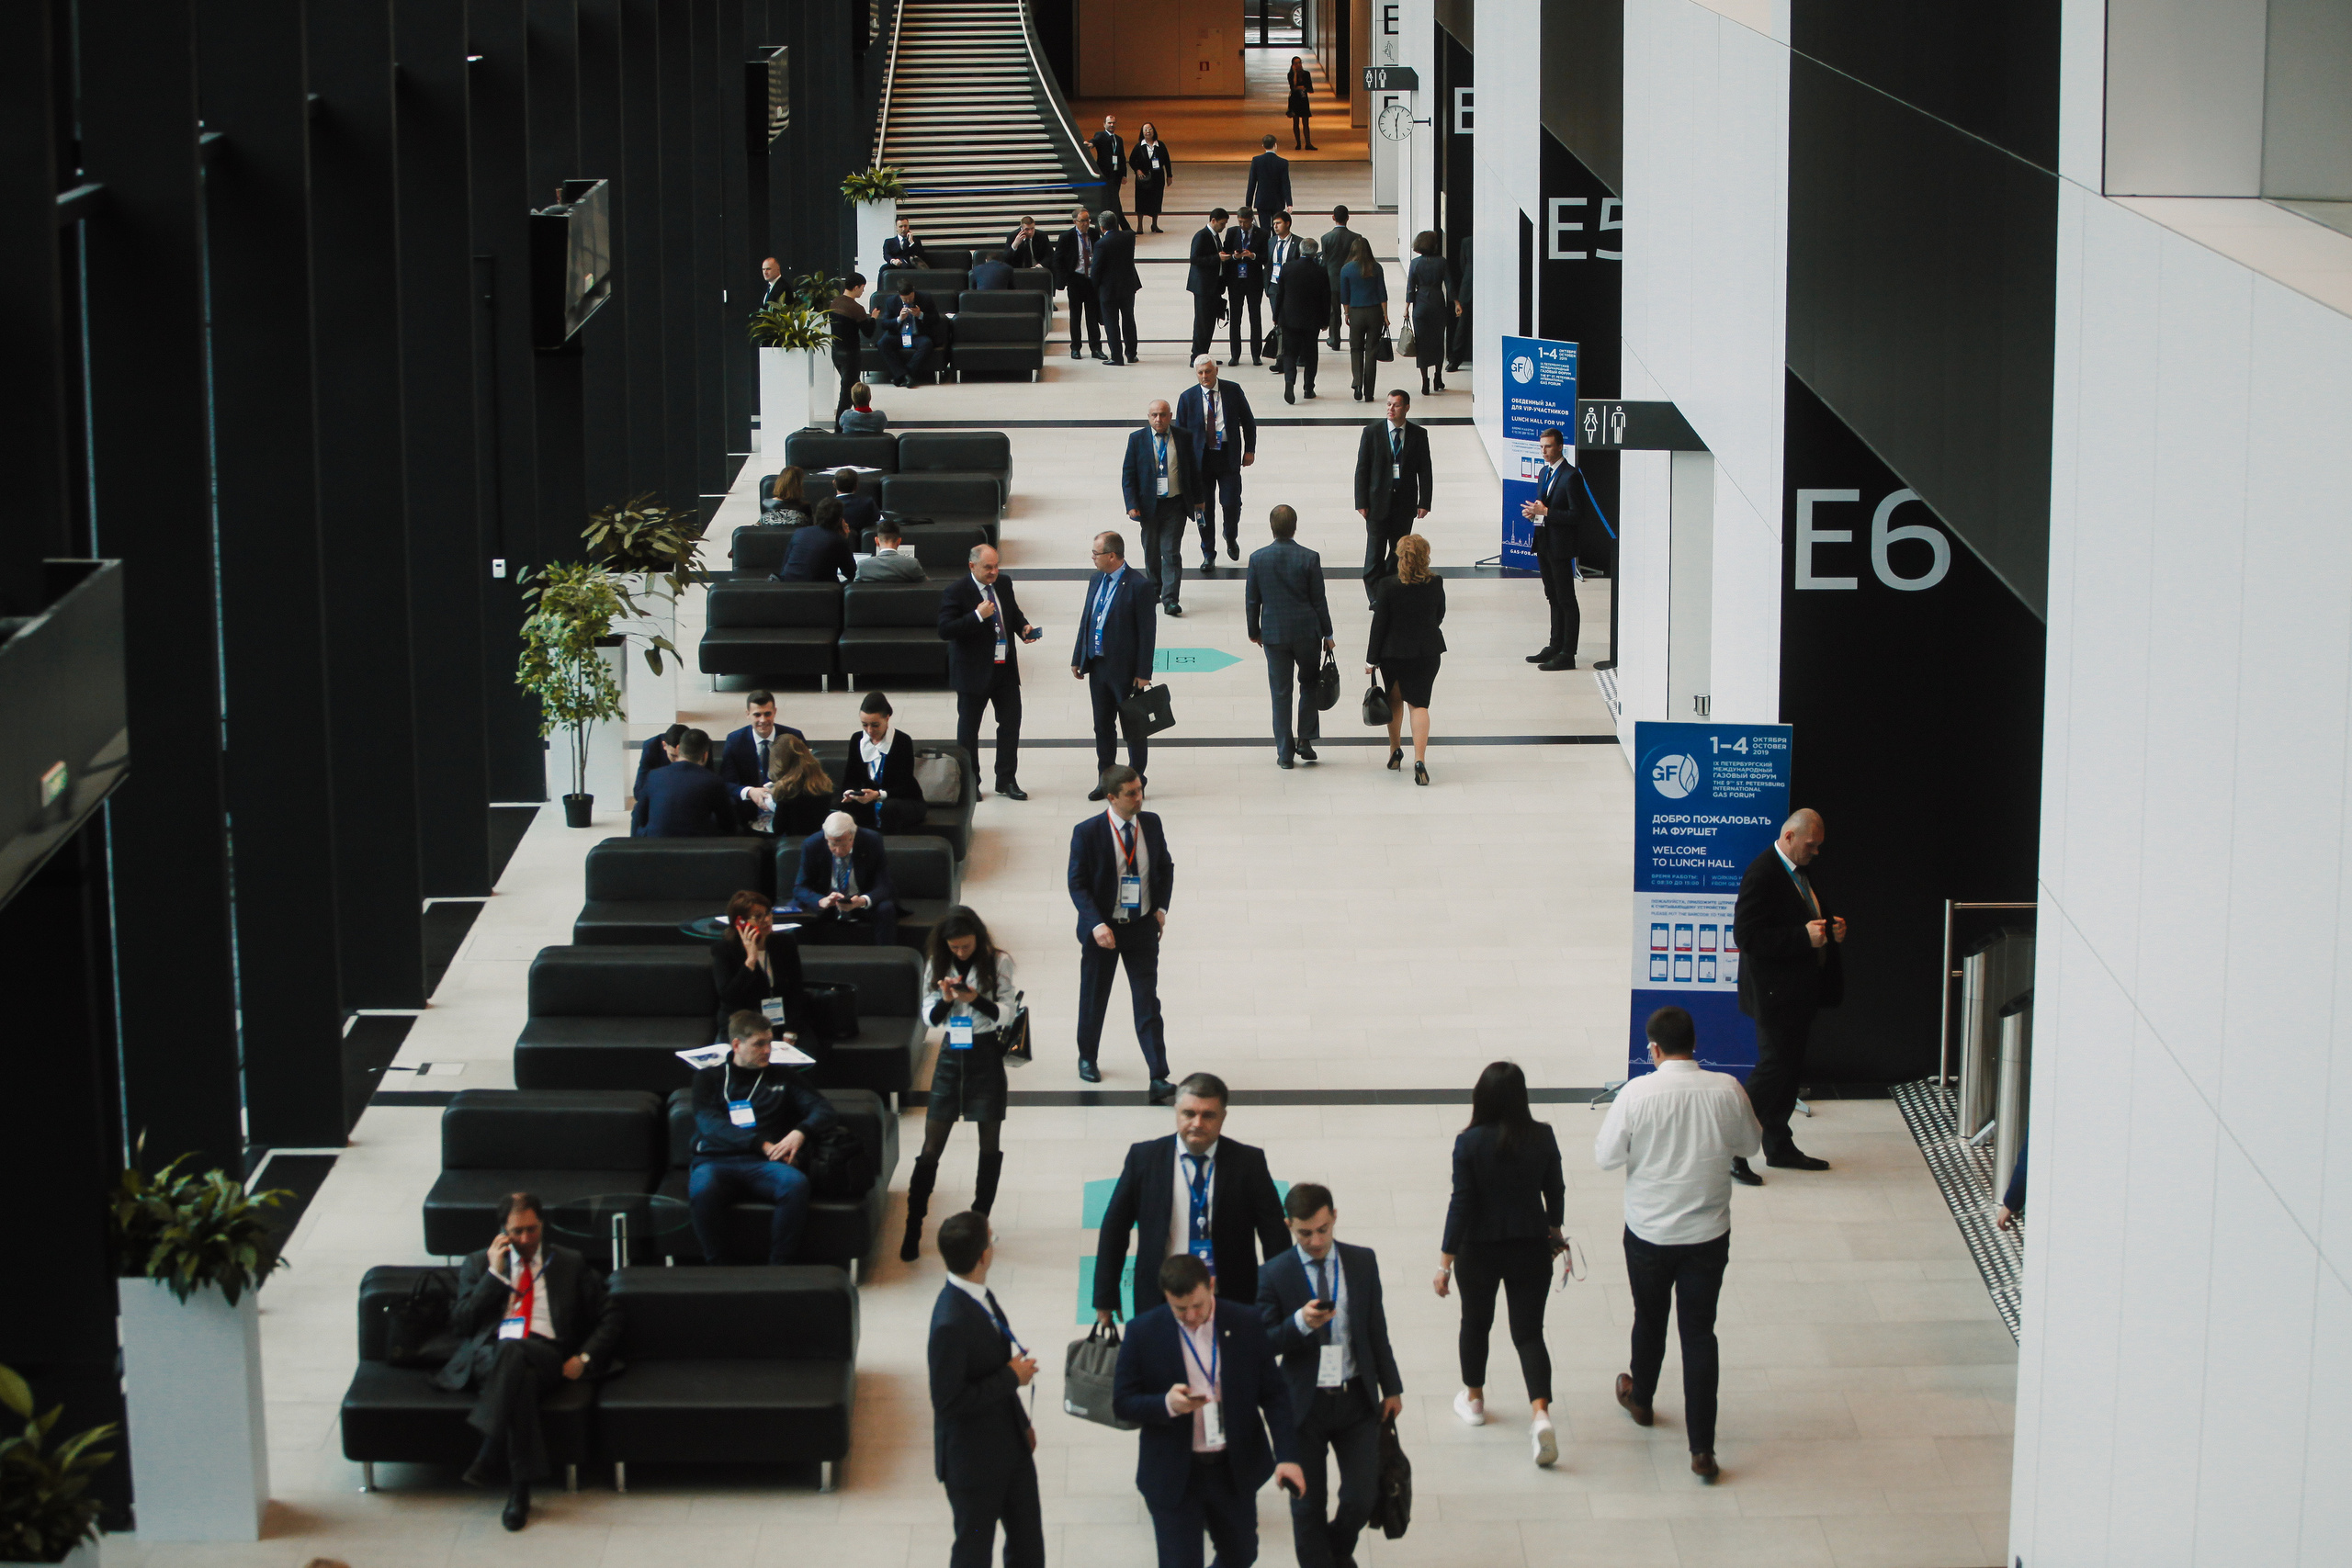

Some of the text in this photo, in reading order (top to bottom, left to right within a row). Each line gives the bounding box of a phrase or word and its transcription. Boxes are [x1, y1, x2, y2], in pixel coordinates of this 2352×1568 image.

[1548, 197, 1623, 260] E5
[1511, 363, 1523, 372] GF
[1511, 398, 1544, 406] ОБЕДЕННЫЙ
[1523, 405, 1569, 415] VIP-УЧАСТНИКОВ
[1795, 488, 1951, 592] E6
[1710, 736, 1748, 755] 1–4
[1652, 765, 1678, 782] GF
[1652, 814, 1771, 825] ДОБРО ПОЖАЛОВАТЬ
[1652, 827, 1718, 836] НА ФУРШЕТ
[1652, 846, 1707, 855] WELCOME
[1652, 858, 1736, 868] TO LUNCH HALL
